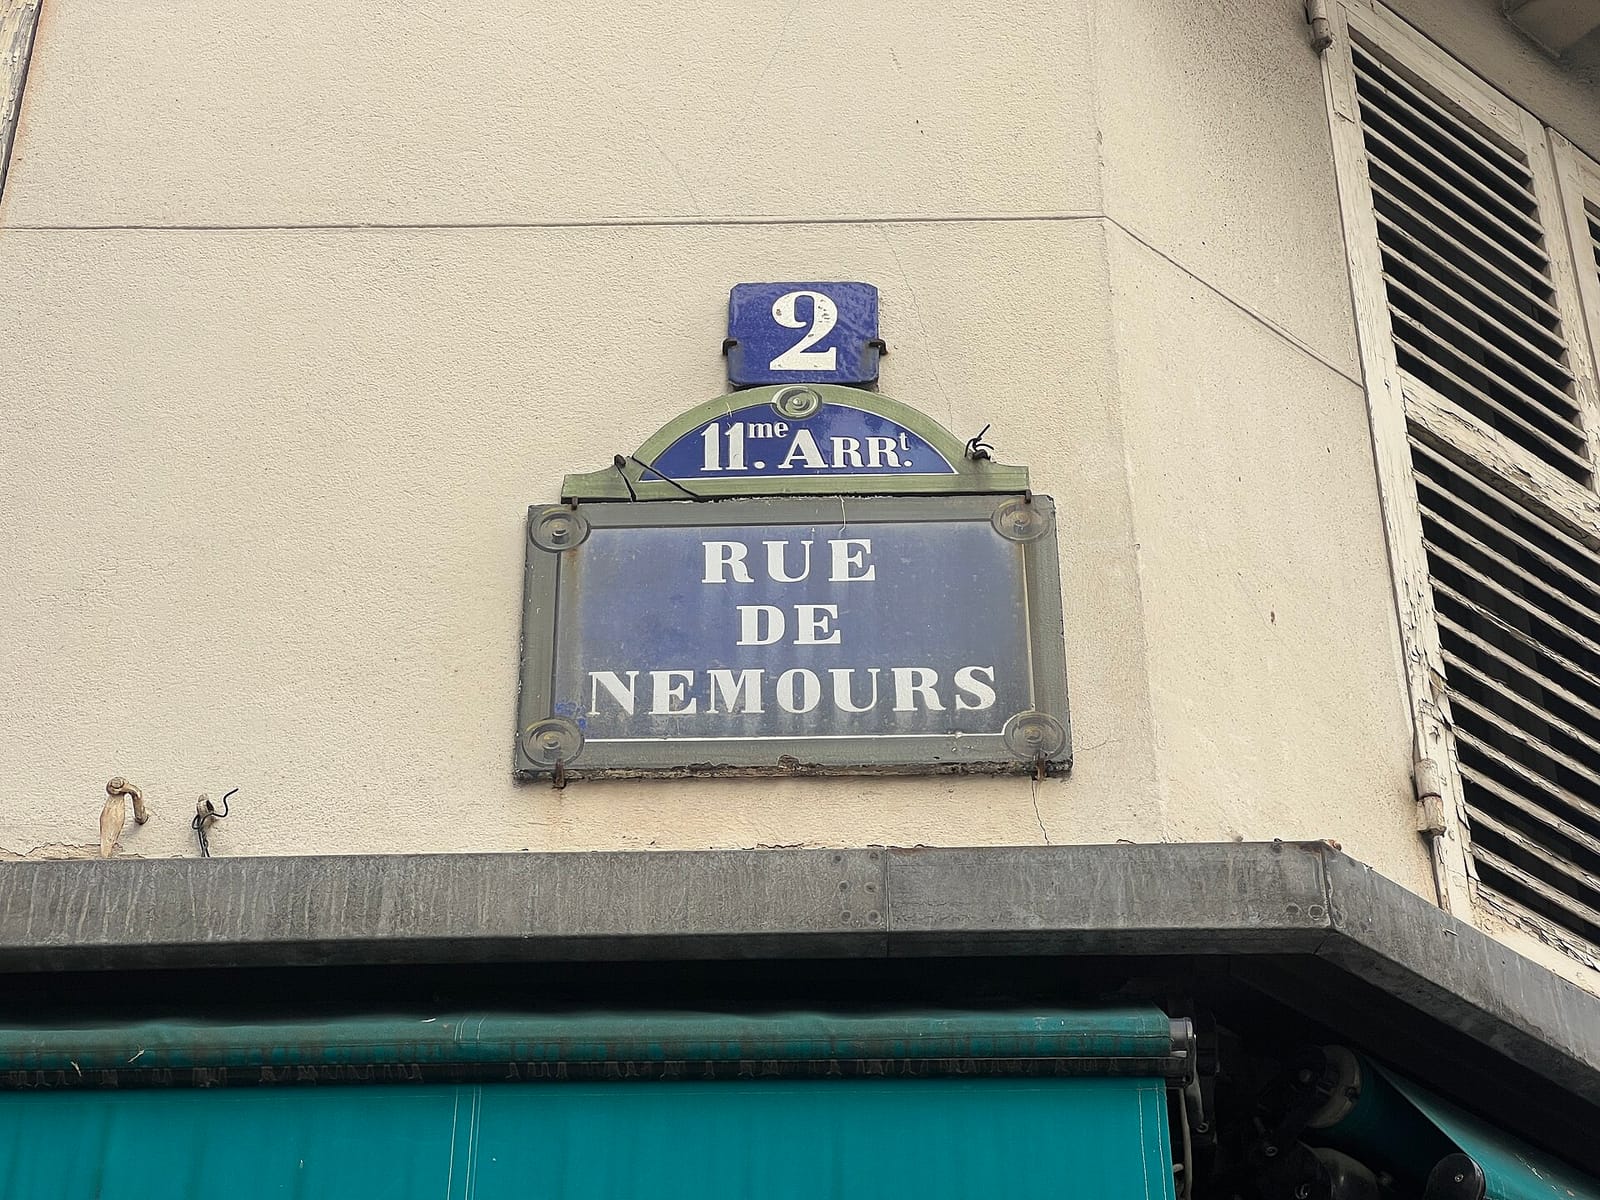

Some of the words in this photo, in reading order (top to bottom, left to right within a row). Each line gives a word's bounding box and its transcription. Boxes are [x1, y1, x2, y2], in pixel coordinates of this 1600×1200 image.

[769, 290, 838, 371] 2
[701, 538, 877, 584] RUE
[736, 603, 842, 647] DE
[588, 665, 997, 716] NEMOURS
